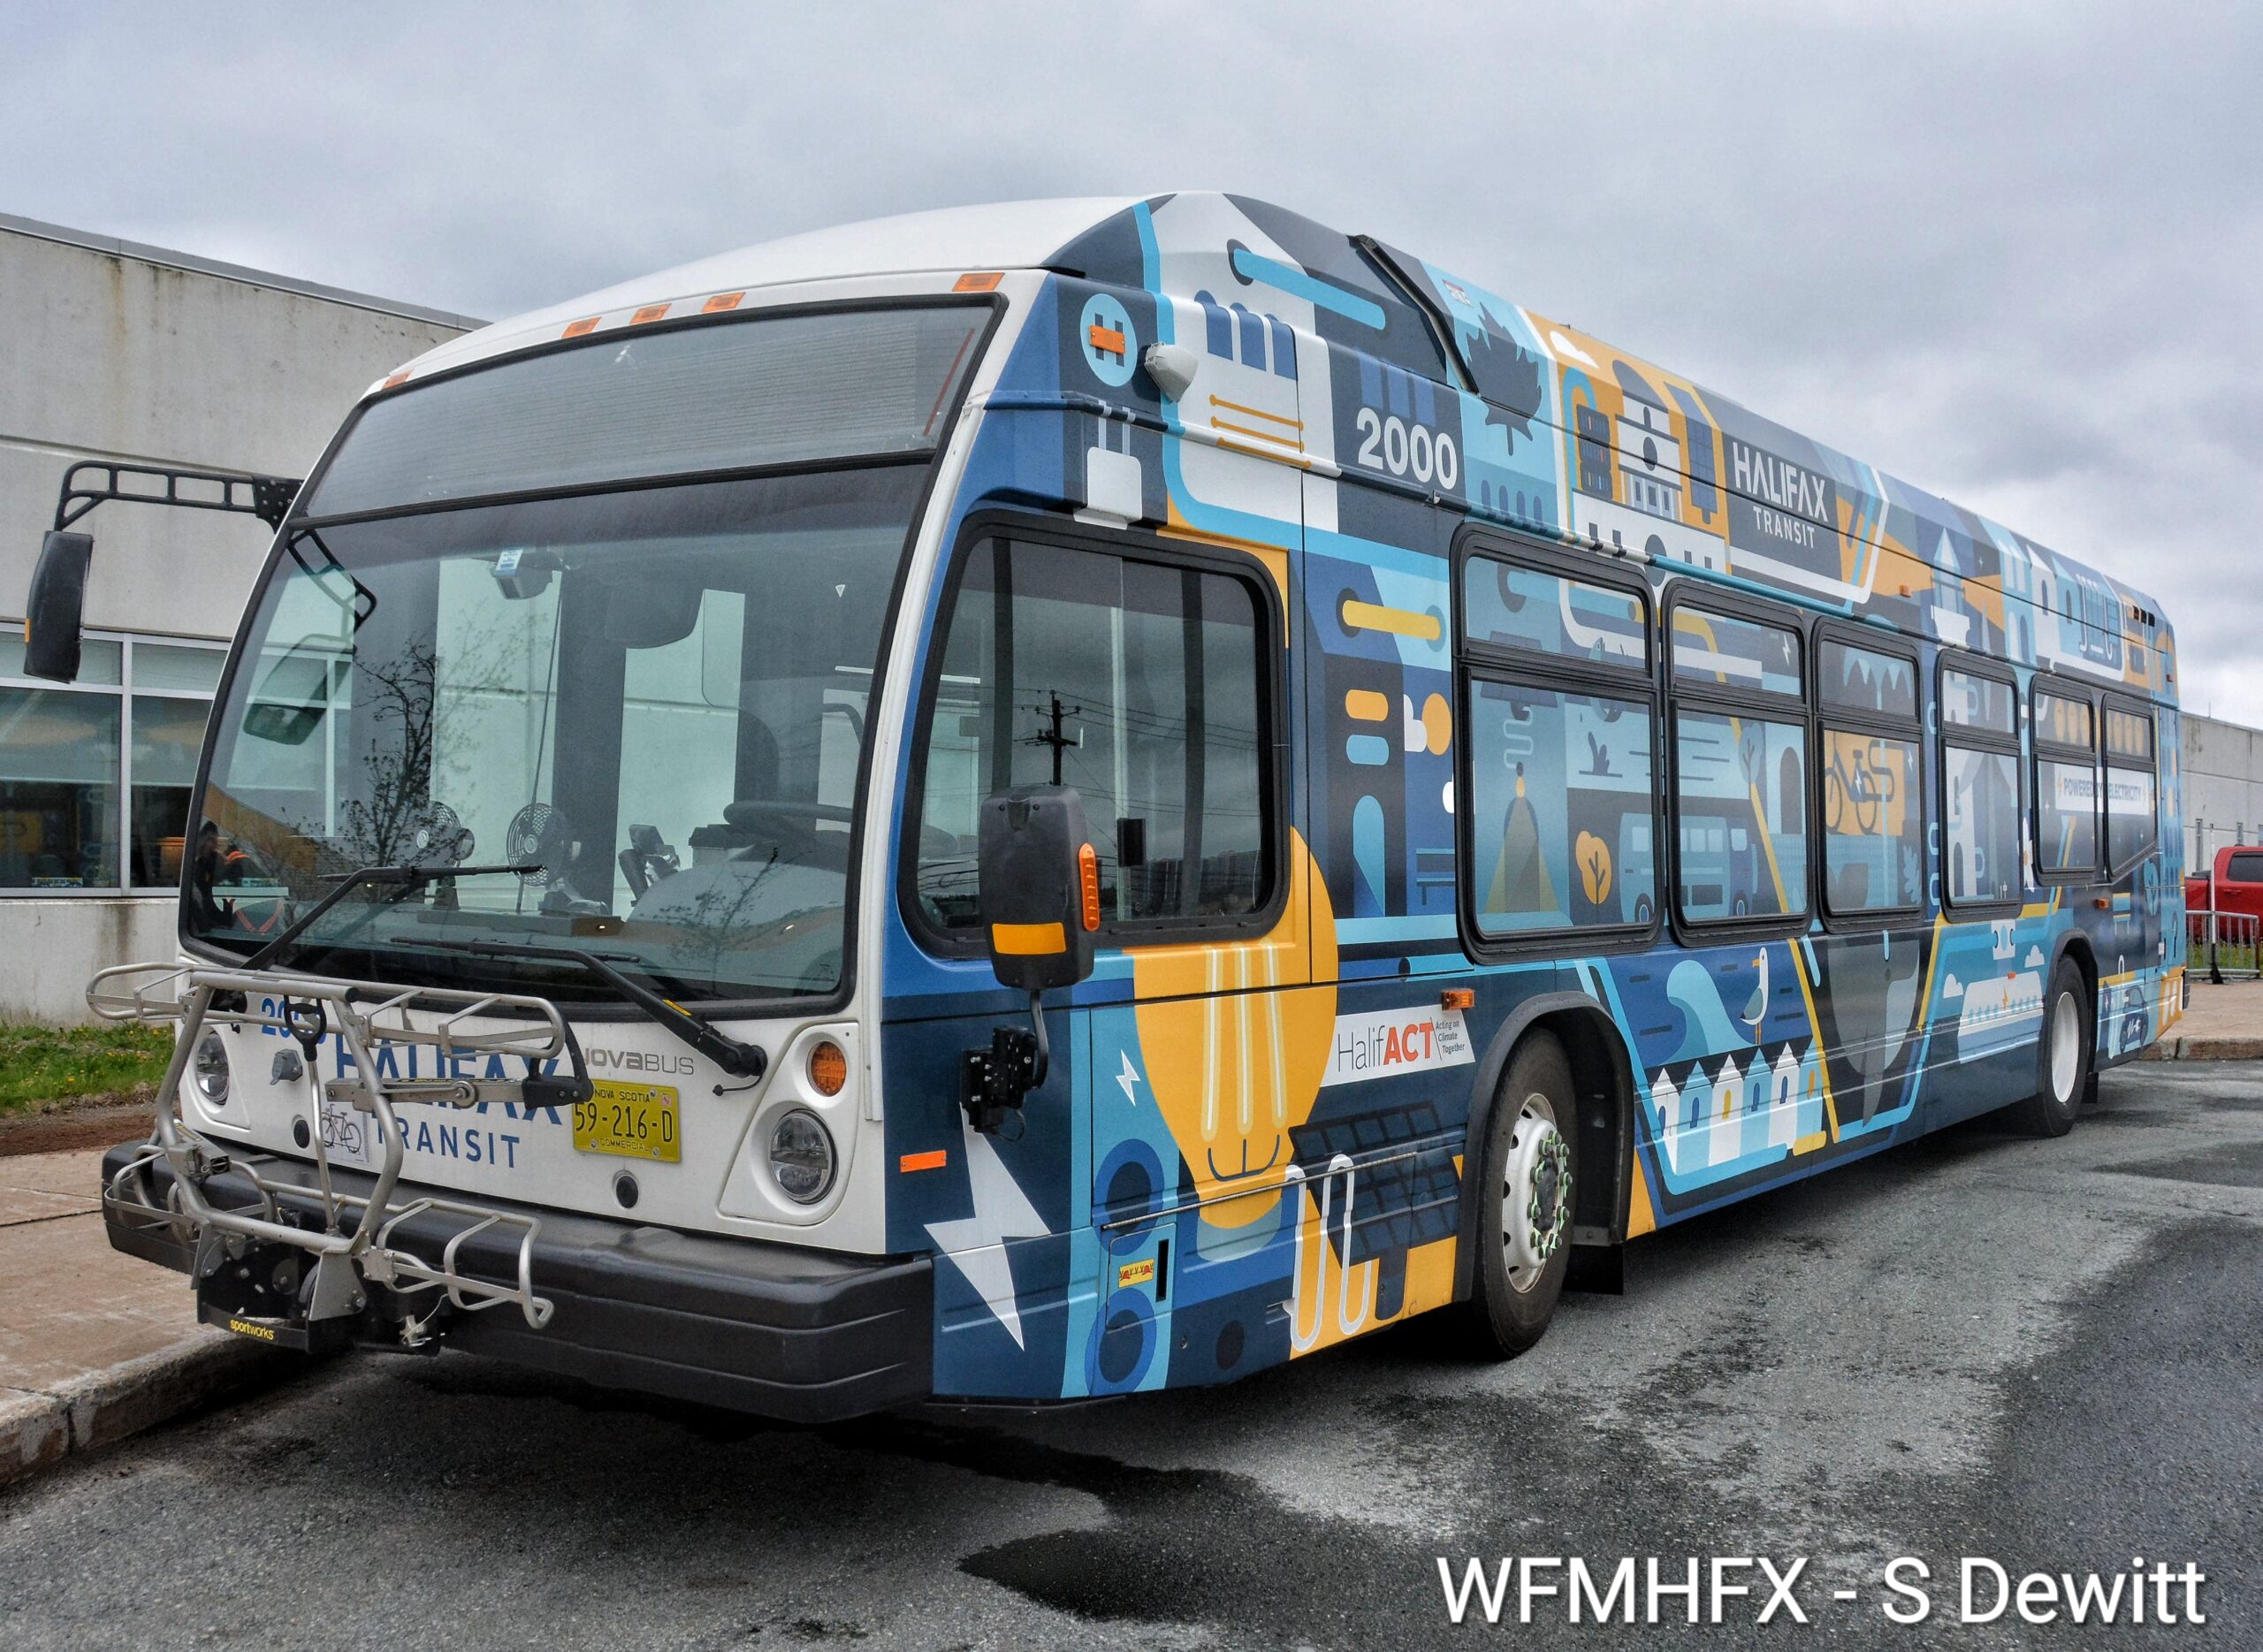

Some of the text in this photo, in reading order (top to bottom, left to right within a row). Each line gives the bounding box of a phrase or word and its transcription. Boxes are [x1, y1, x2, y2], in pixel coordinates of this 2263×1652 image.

[1357, 407, 1458, 490] 2000
[1733, 441, 1828, 522] HALIFAX
[1753, 506, 1815, 548] TRANSIT
[262, 997, 326, 1045] 20
[1436, 1020, 1452, 1031] Acting
[1337, 1022, 1434, 1072] HalifACT
[1437, 1032, 1458, 1042] Climate
[1442, 1043, 1465, 1054] Together
[595, 1089, 614, 1100] NOVA
[619, 1091, 650, 1103] SCOTIA
[575, 1101, 673, 1142] 59-216-D
[599, 1138, 650, 1152] COMMERCIAL
[230, 1319, 275, 1340] sportworks
